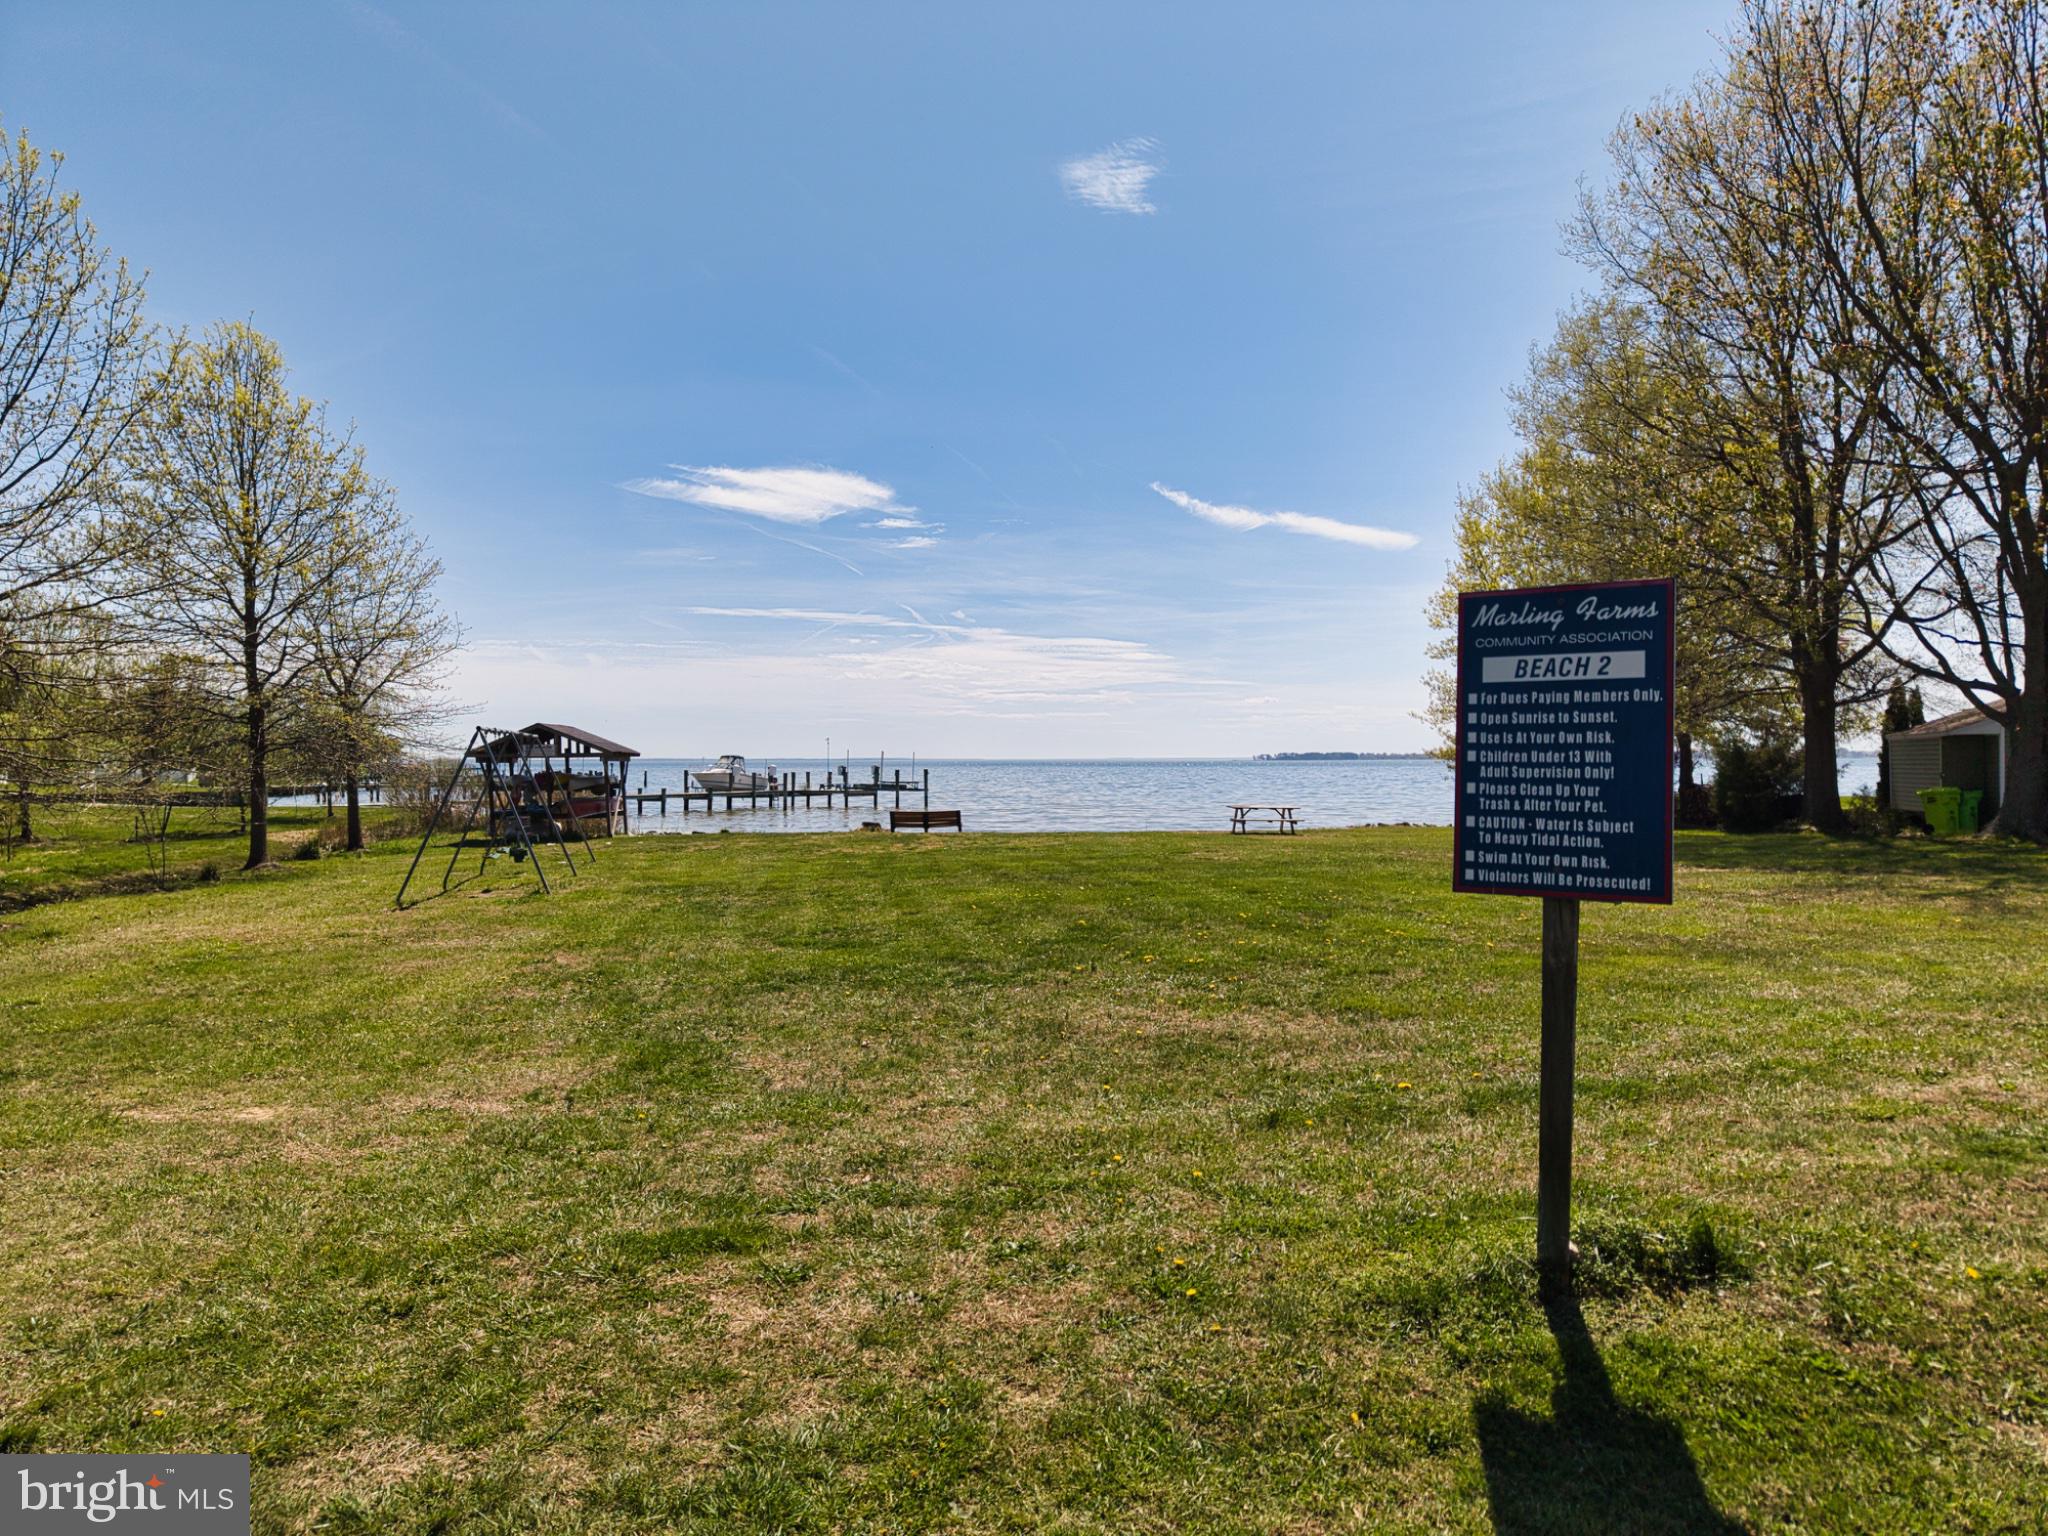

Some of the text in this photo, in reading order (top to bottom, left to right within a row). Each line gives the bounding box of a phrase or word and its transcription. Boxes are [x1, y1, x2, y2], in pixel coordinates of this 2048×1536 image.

[1472, 596, 1658, 631] Marling Farms
[1476, 630, 1653, 648] COMMUNITY ASSOCIATION
[1514, 656, 1612, 678] BEACH 2
[1481, 689, 1663, 704] For Dues Paying Members Only.
[1481, 711, 1617, 726] Open Sunrise to Sunset.
[1480, 732, 1615, 744] Use Is At Your Own Risk.
[1480, 751, 1612, 763] Children Under 13 With
[1480, 766, 1614, 780] Adult Supervision Only!
[1480, 783, 1600, 797] Please Clean Up Your
[1480, 798, 1607, 813] Trash & After Your Pet.
[1479, 816, 1525, 829] CAUTION
[1536, 818, 1570, 831] Water
[1574, 820, 1583, 831] Is
[1587, 820, 1634, 833] Subject
[1479, 832, 1604, 848] To Heavy Tidal Action.
[1478, 851, 1610, 869] Swim At Your Own Risk.
[1478, 869, 1650, 890] Violators Will Be Prosecuted!
